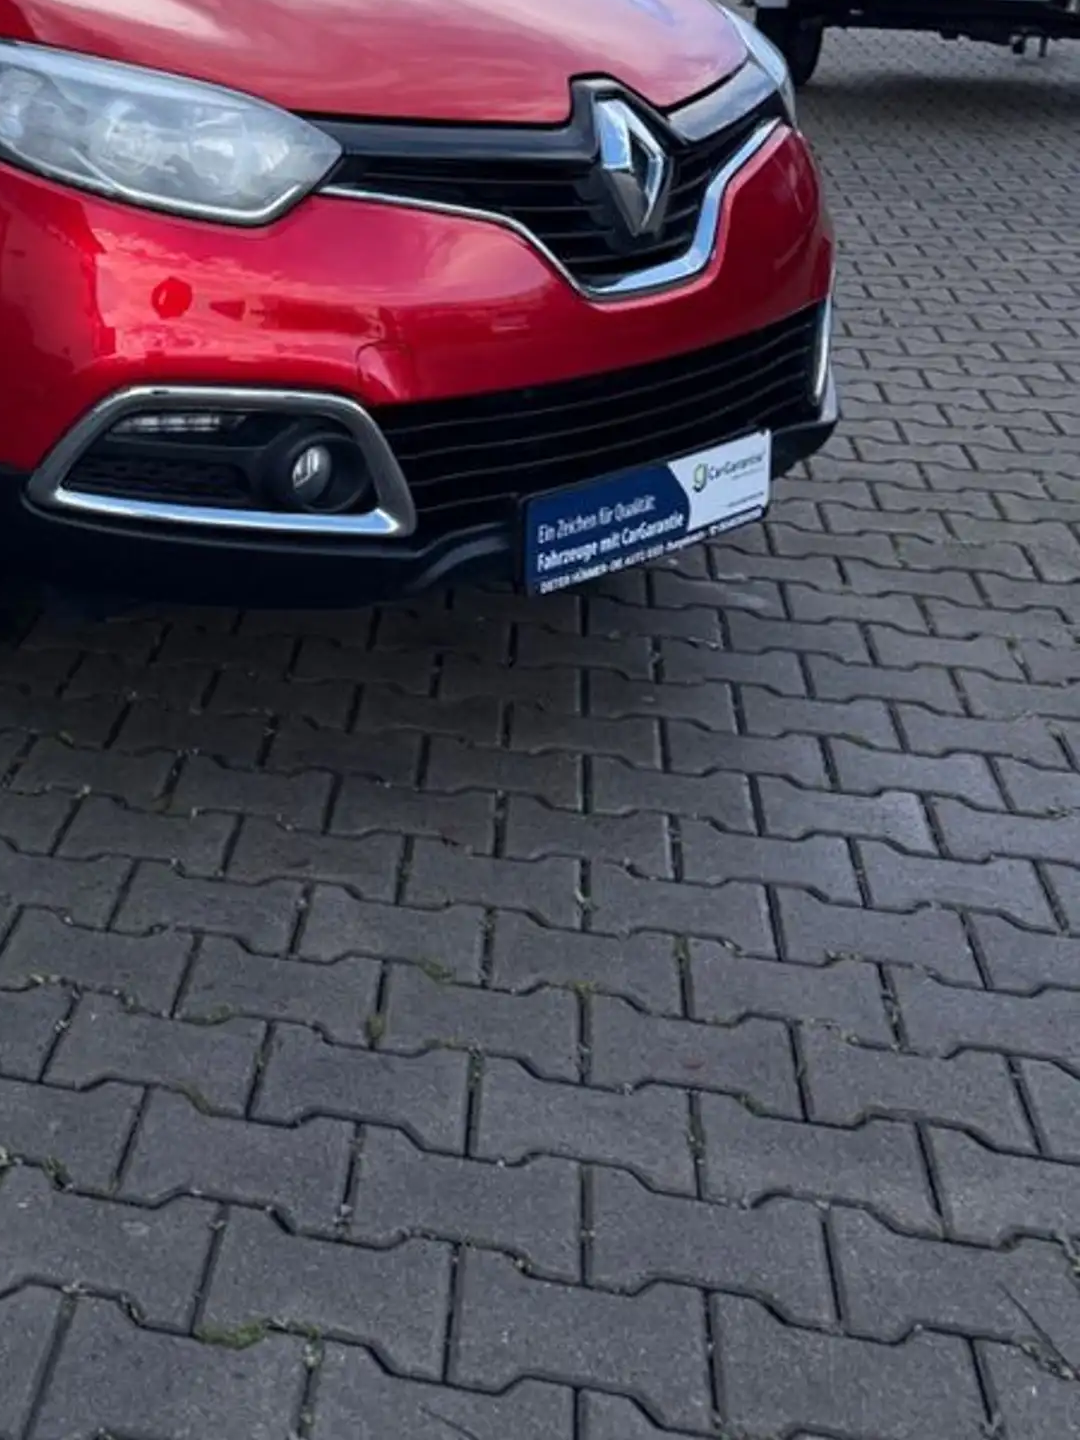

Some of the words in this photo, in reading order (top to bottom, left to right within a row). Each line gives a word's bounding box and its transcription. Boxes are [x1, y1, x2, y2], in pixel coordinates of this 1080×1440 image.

[537, 523, 556, 544] Ein
[556, 514, 597, 540] Zeichen
[597, 505, 613, 525] für
[537, 541, 597, 573] Fahrzeuge
[599, 531, 621, 553] mit
[621, 509, 684, 545] CarGarantie
